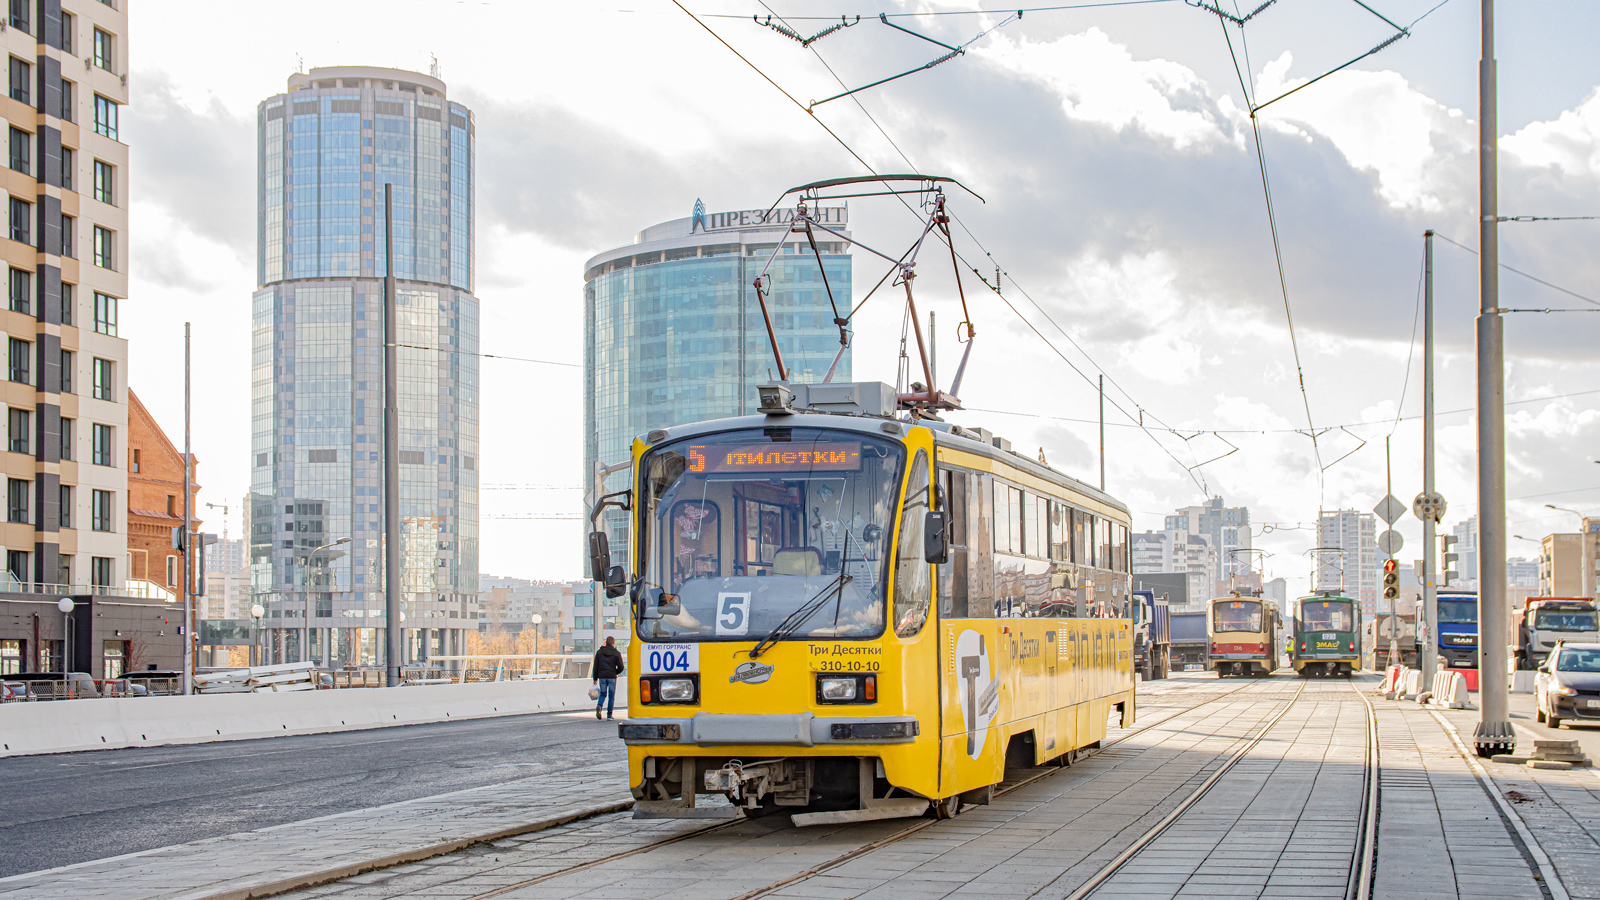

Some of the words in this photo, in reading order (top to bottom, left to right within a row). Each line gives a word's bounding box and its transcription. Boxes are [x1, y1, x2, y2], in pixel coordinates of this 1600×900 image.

[711, 207, 845, 228] ПРЕЗИДНТ
[689, 445, 705, 472] 5
[719, 596, 745, 630] 5
[808, 644, 829, 656] Три
[831, 644, 882, 656] Десятки
[649, 650, 690, 672] 004
[820, 660, 880, 671] 310-10-10
